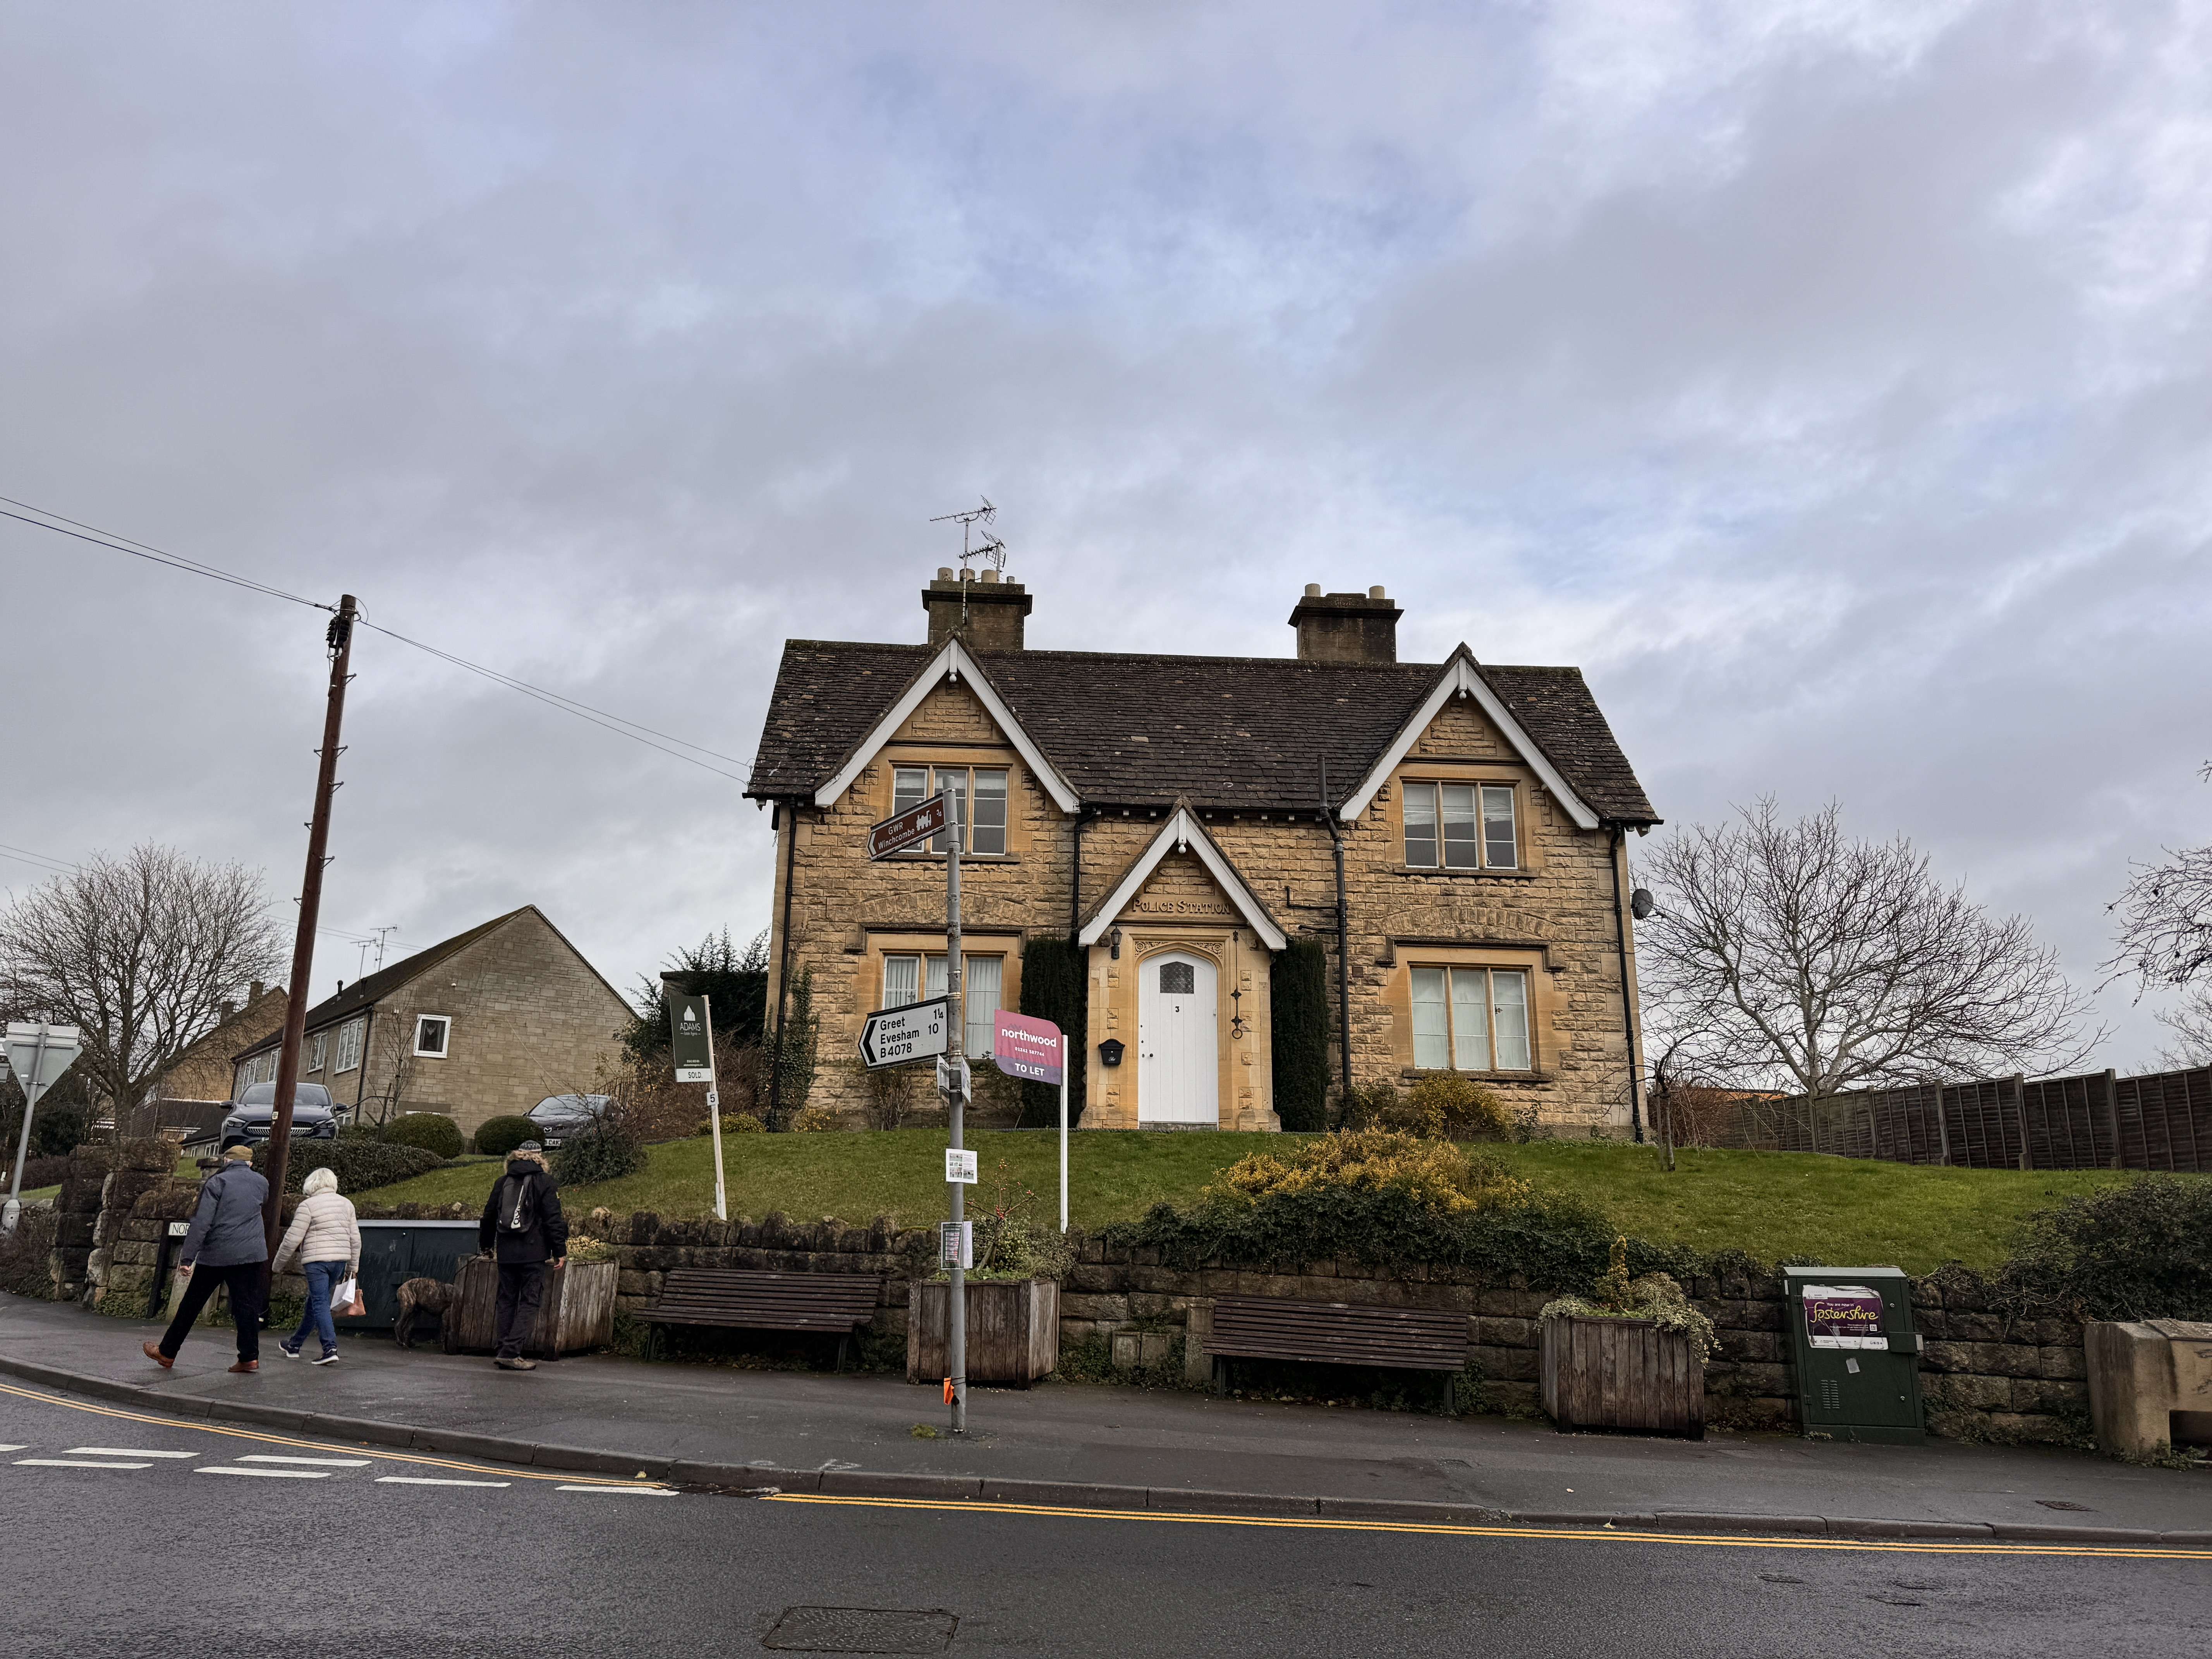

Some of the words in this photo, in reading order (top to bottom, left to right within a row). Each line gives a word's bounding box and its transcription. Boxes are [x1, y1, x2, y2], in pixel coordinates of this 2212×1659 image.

[888, 822, 903, 835] GWR
[878, 828, 915, 850] Winchcombe
[1132, 898, 1174, 912] POLICE
[1177, 900, 1230, 915] STATION
[680, 1022, 701, 1031] ADAMS
[880, 1016, 905, 1031] Greet
[880, 1030, 919, 1044] Evesham
[928, 1023, 939, 1035] 10
[1001, 1028, 1057, 1048] northwood
[1015, 1063, 1027, 1073] TO
[1029, 1066, 1045, 1076] LET
[710, 1094, 715, 1103] 5
[1810, 1302, 1879, 1323] fostershire
